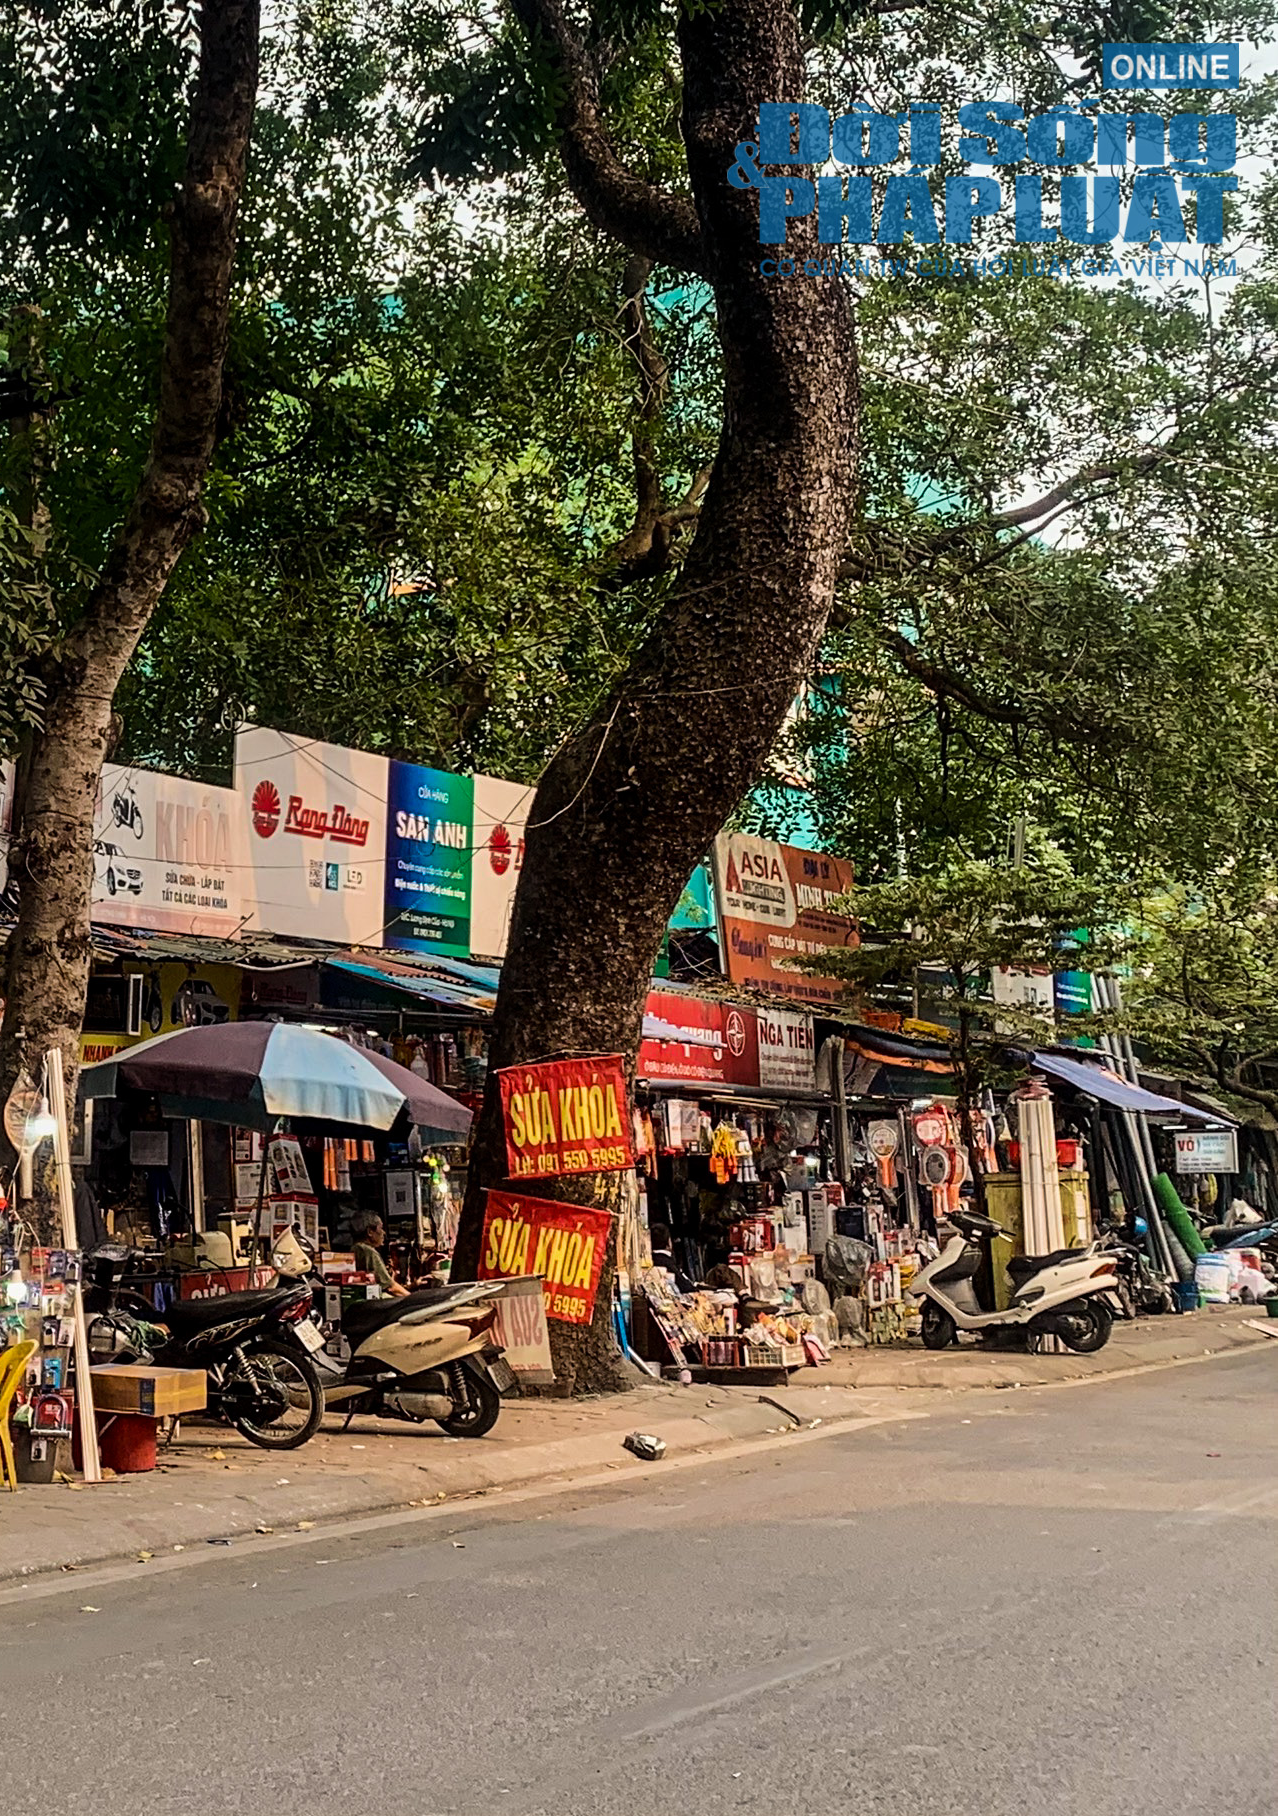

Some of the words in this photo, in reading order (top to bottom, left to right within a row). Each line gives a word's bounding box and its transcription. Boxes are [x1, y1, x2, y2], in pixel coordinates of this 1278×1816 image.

[155, 797, 233, 873] KHÓA
[432, 819, 467, 849] ANH
[165, 870, 178, 884] SỬA
[179, 873, 196, 887] CHỮA
[741, 851, 783, 882] ASIA
[162, 887, 173, 901] TẤT
[183, 890, 196, 905] CÁC
[760, 1022, 784, 1047] NGA
[786, 1018, 814, 1050] TIẾN
[511, 1074, 557, 1147] SỬA
[559, 1073, 622, 1141] KHÓA
[515, 1155, 535, 1175] LH:
[538, 1153, 559, 1172] 091
[563, 1150, 588, 1169] 550
[591, 1145, 626, 1168] 5995
[485, 1203, 530, 1275] SỬA
[534, 1222, 595, 1290] KHÓA
[553, 1294, 586, 1318] 5995
